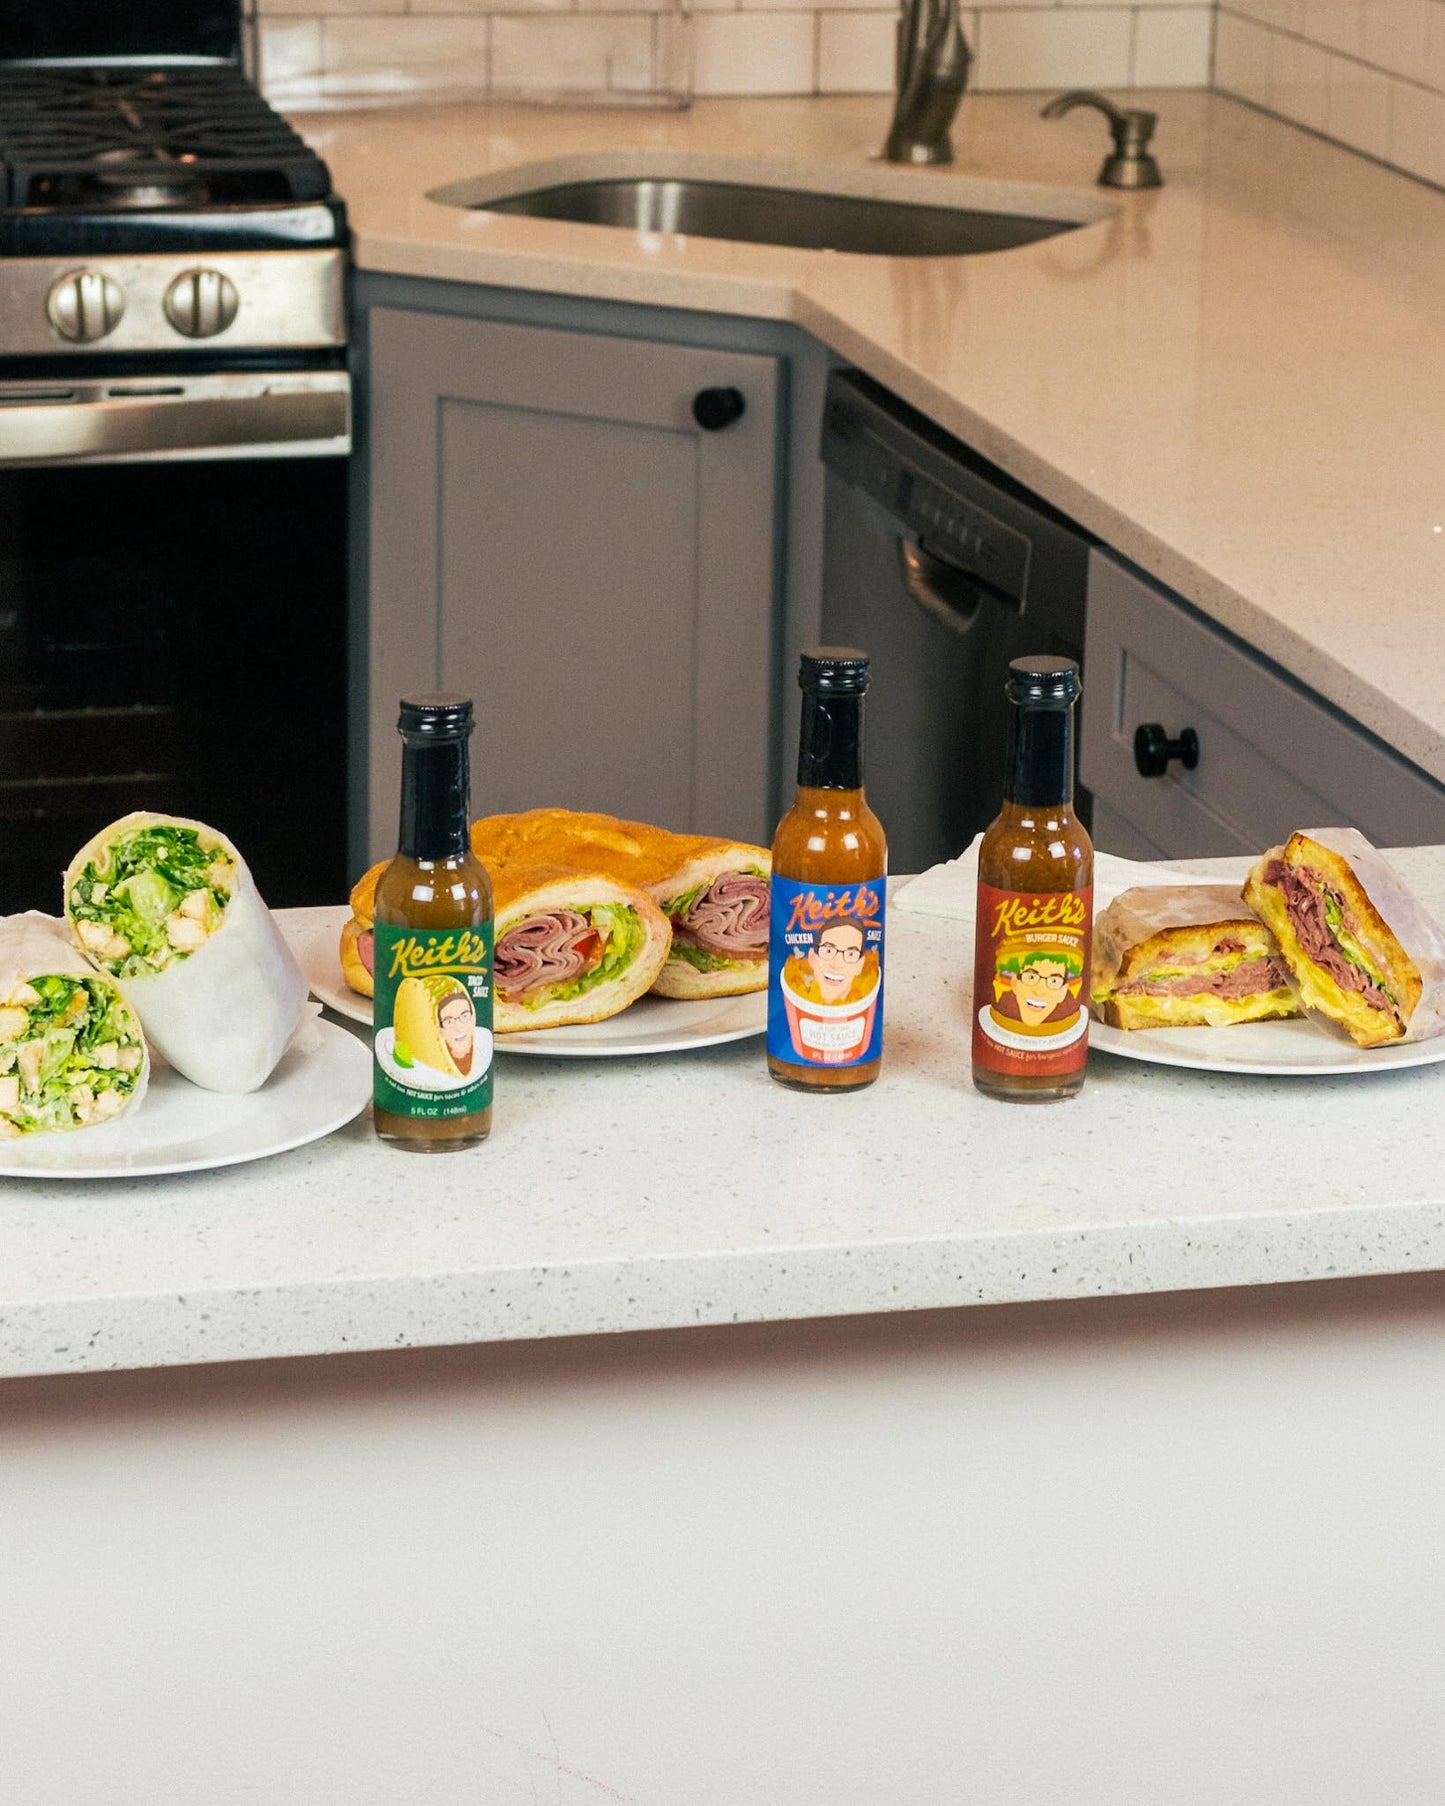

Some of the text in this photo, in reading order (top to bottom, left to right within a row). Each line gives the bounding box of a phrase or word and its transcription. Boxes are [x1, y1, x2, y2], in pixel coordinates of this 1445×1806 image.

[785, 886, 881, 931] Keith's
[991, 892, 1087, 937] Keith's
[784, 932, 814, 945] CHICKEN
[866, 929, 882, 941] SAUCE
[1025, 932, 1080, 948] BURGER SAUCE
[387, 930, 489, 978] Keith's
[467, 975, 484, 987] TACO
[472, 986, 489, 998] SAUCE
[808, 1029, 827, 1041] HOT
[993, 1043, 1006, 1055] HOT
[1005, 1047, 1026, 1060] SAUCE
[406, 1088, 417, 1098] HOT
[416, 1091, 433, 1101] SAUCE
[410, 1106, 417, 1115] 5
[417, 1106, 427, 1116] FL
[427, 1106, 439, 1116] OZ
